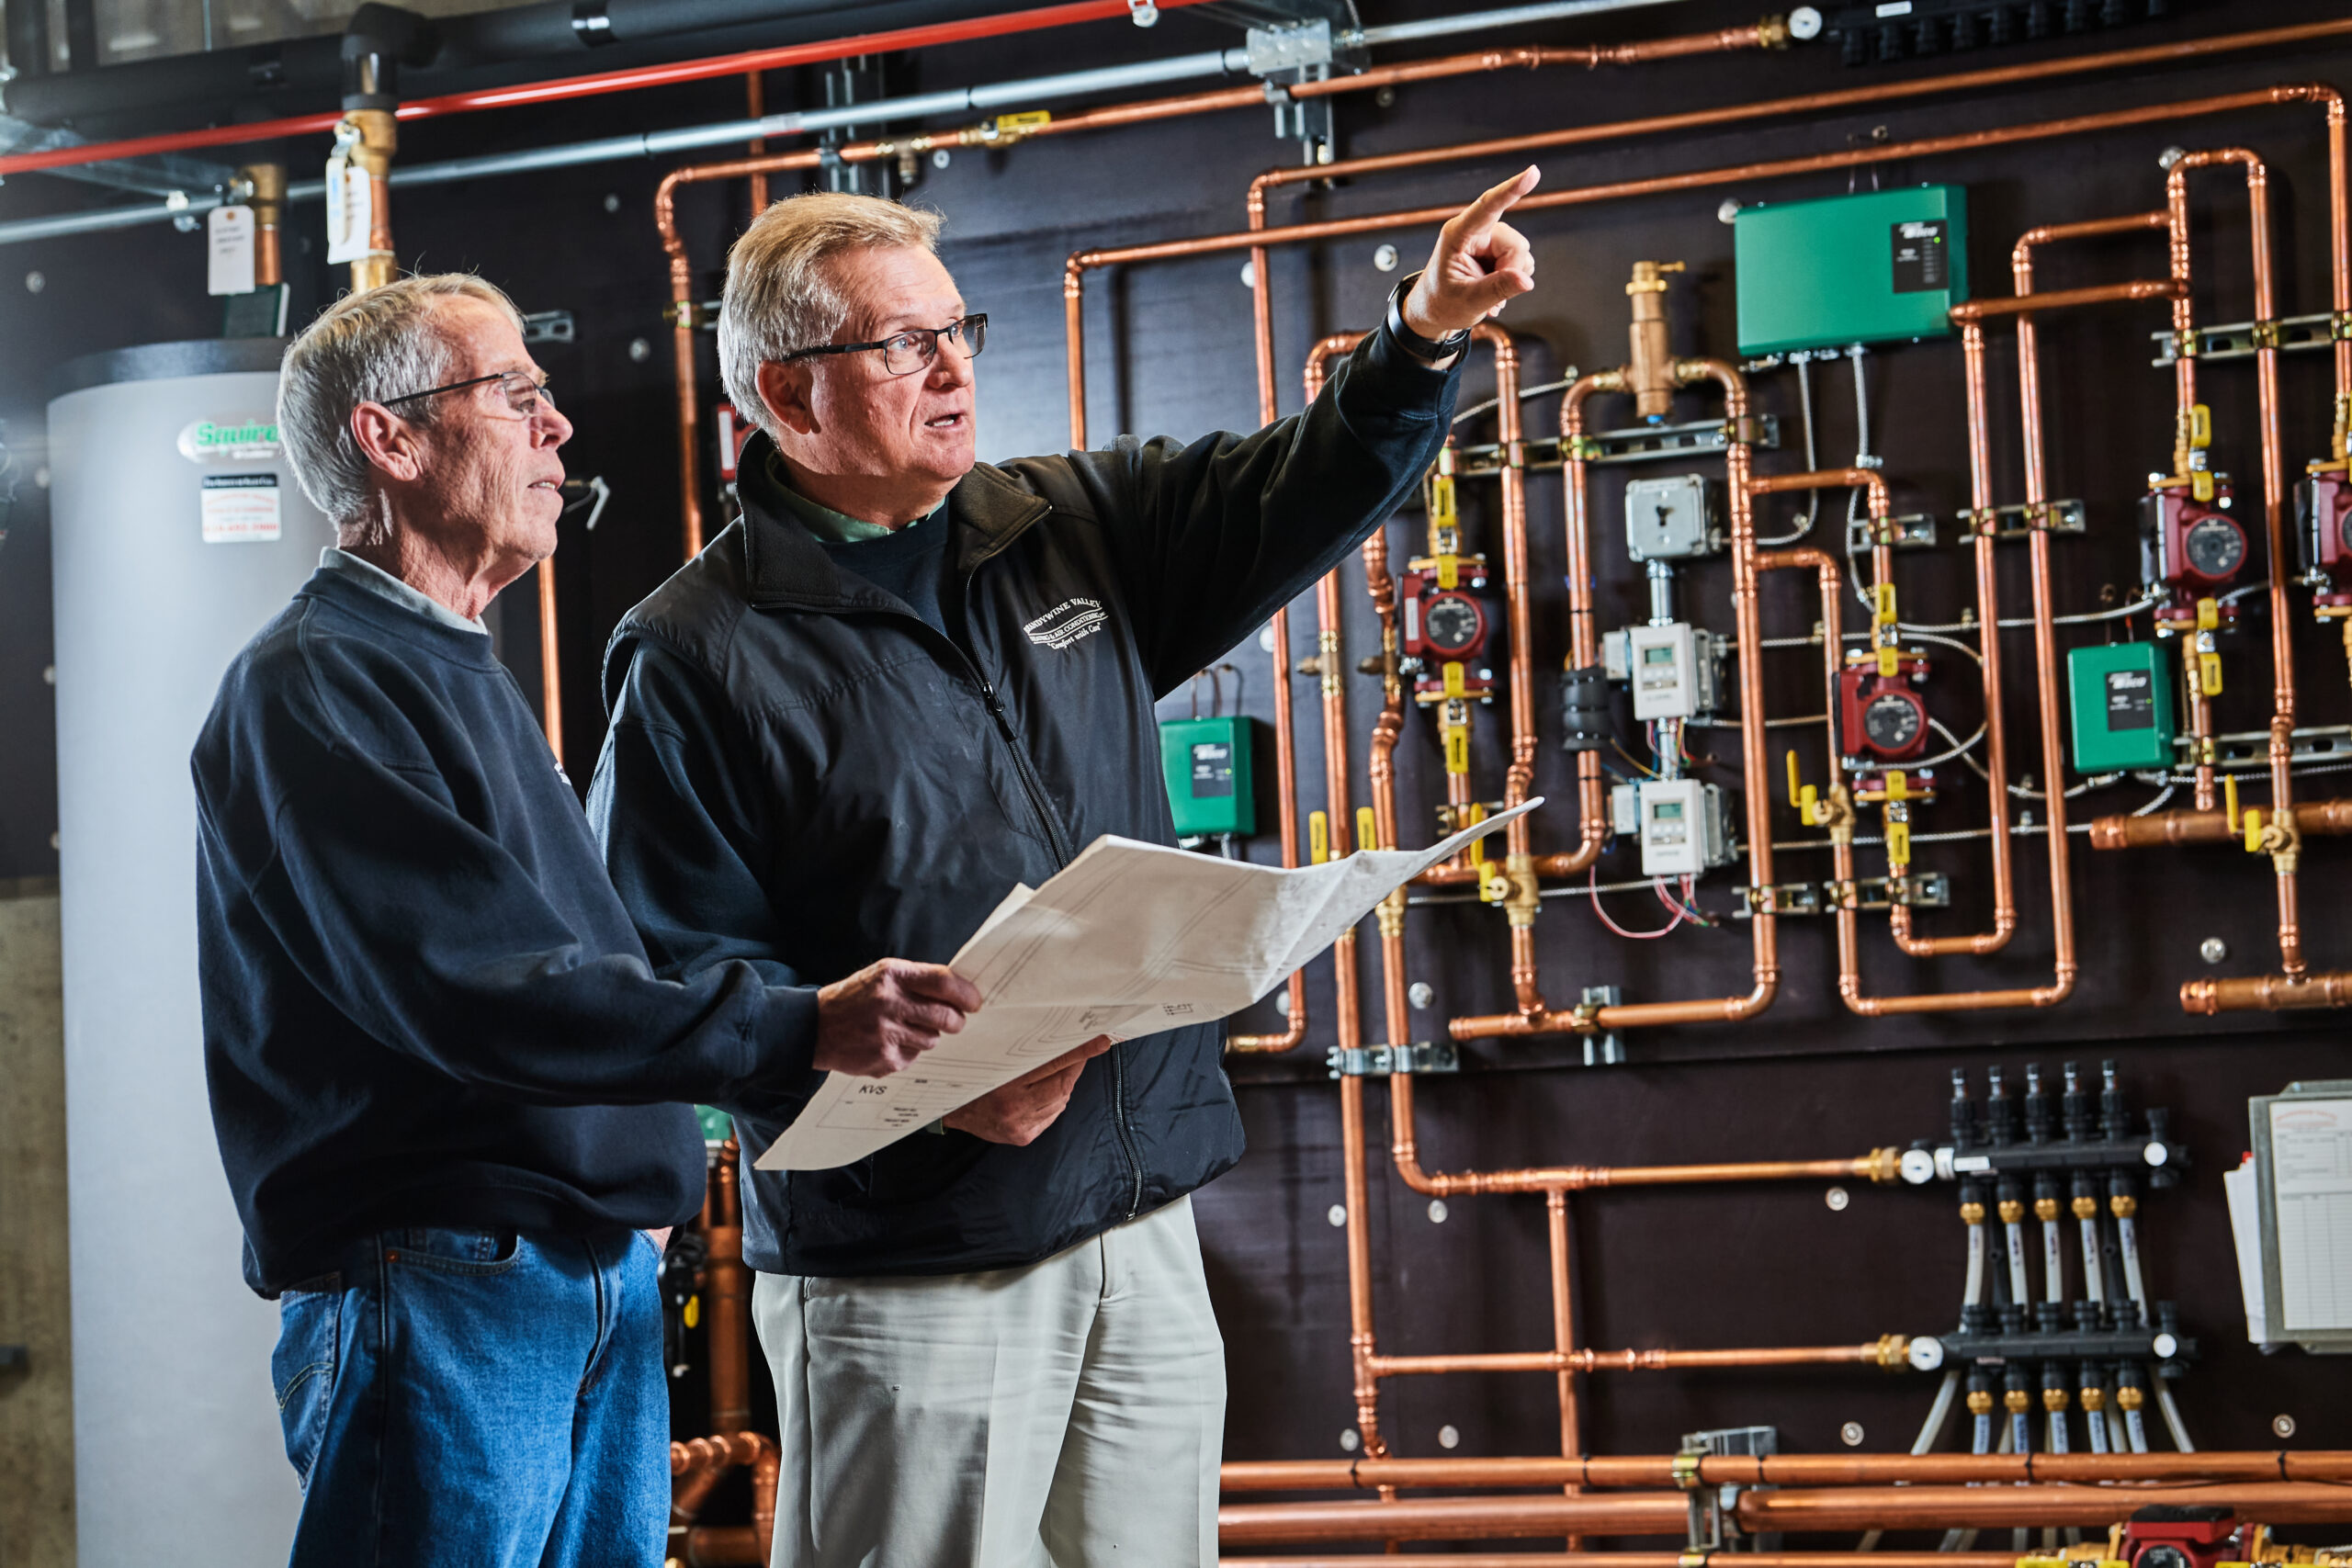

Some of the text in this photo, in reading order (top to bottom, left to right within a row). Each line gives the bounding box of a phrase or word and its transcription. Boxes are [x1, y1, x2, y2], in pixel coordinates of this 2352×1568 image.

[1069, 597, 1102, 608] VALLEY
[1074, 627, 1090, 640] with
[858, 1084, 888, 1095] KVS
